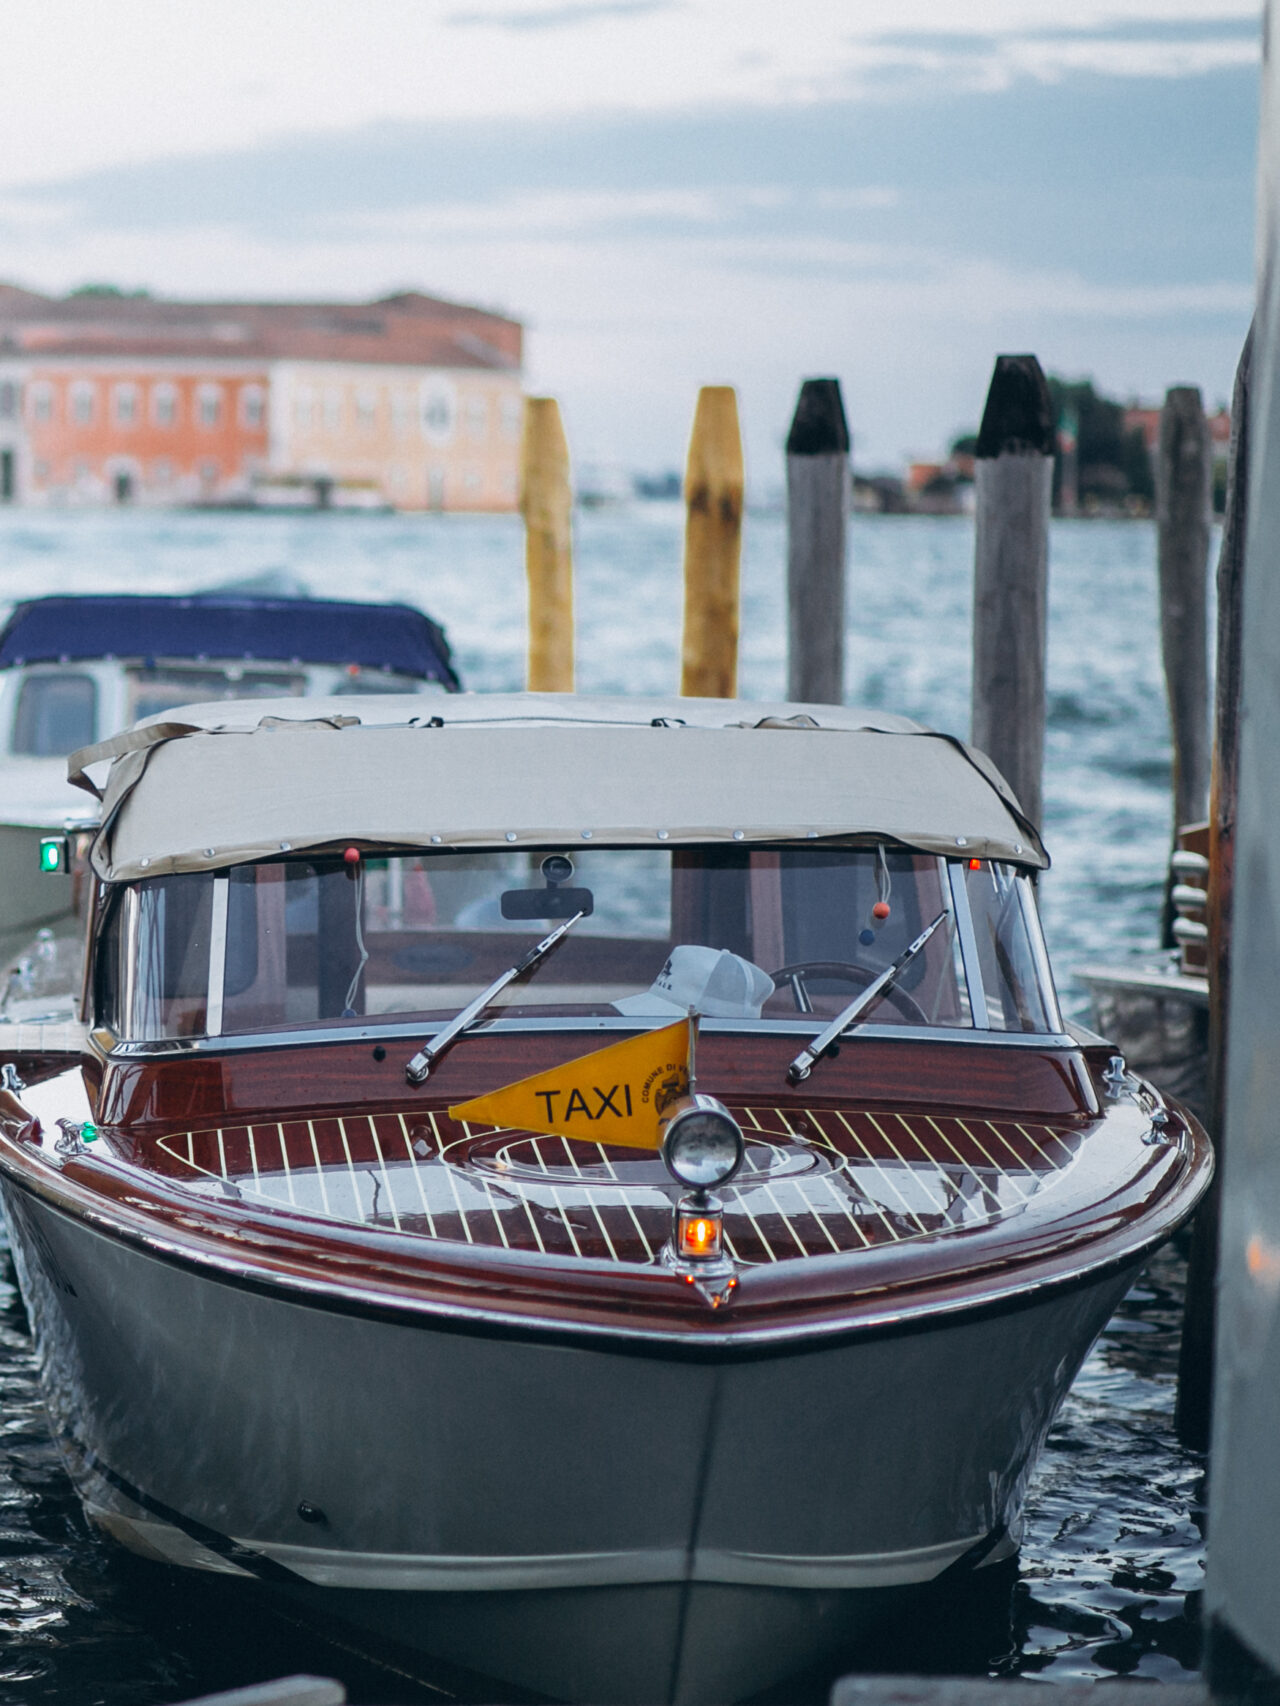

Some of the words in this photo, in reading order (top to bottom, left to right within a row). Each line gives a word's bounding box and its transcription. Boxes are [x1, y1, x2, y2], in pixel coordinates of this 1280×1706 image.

[641, 1066, 665, 1104] COMUNE
[666, 1063, 677, 1072] DI
[535, 1084, 633, 1124] TAXI
